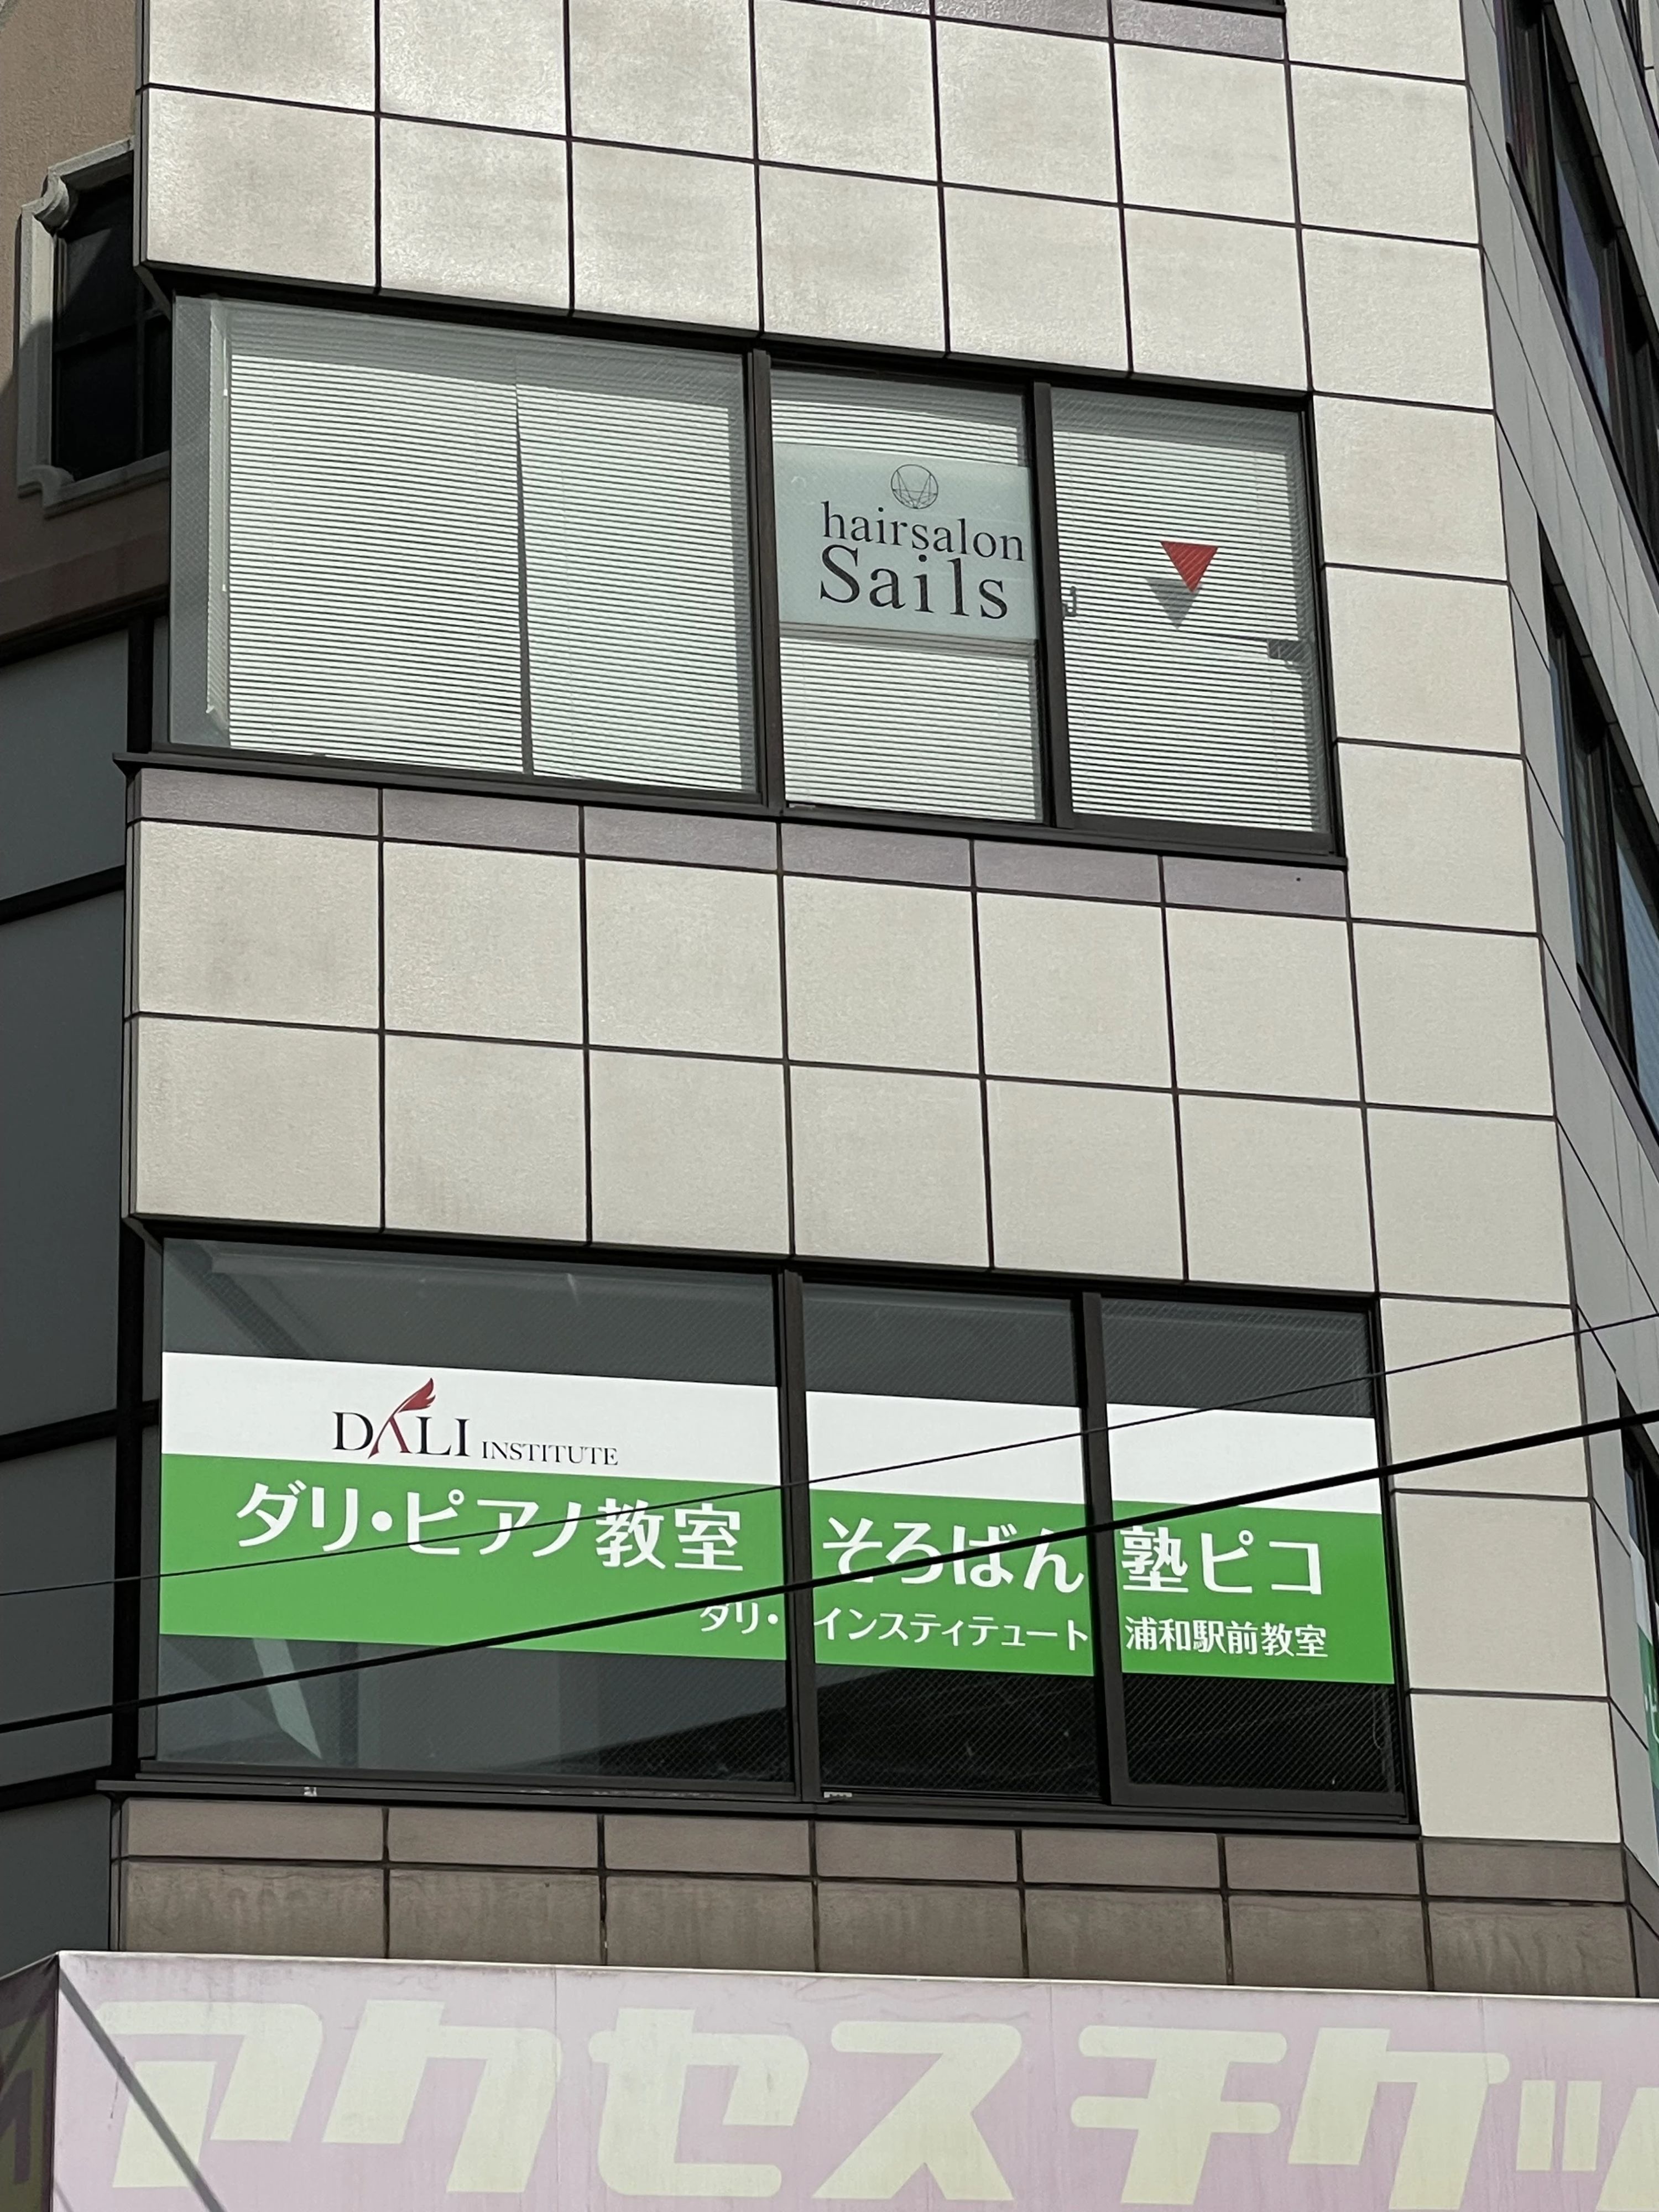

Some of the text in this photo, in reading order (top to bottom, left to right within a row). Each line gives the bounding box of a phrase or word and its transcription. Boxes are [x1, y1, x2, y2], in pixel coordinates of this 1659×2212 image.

[820, 500, 1025, 562] hairsalon
[820, 544, 1008, 620] Sails
[332, 1378, 619, 1466] DALI INSTITUTE
[236, 1479, 744, 1572] ダリ・ピアノ教室
[1124, 1615, 1328, 1658] 浦和駅前教室
